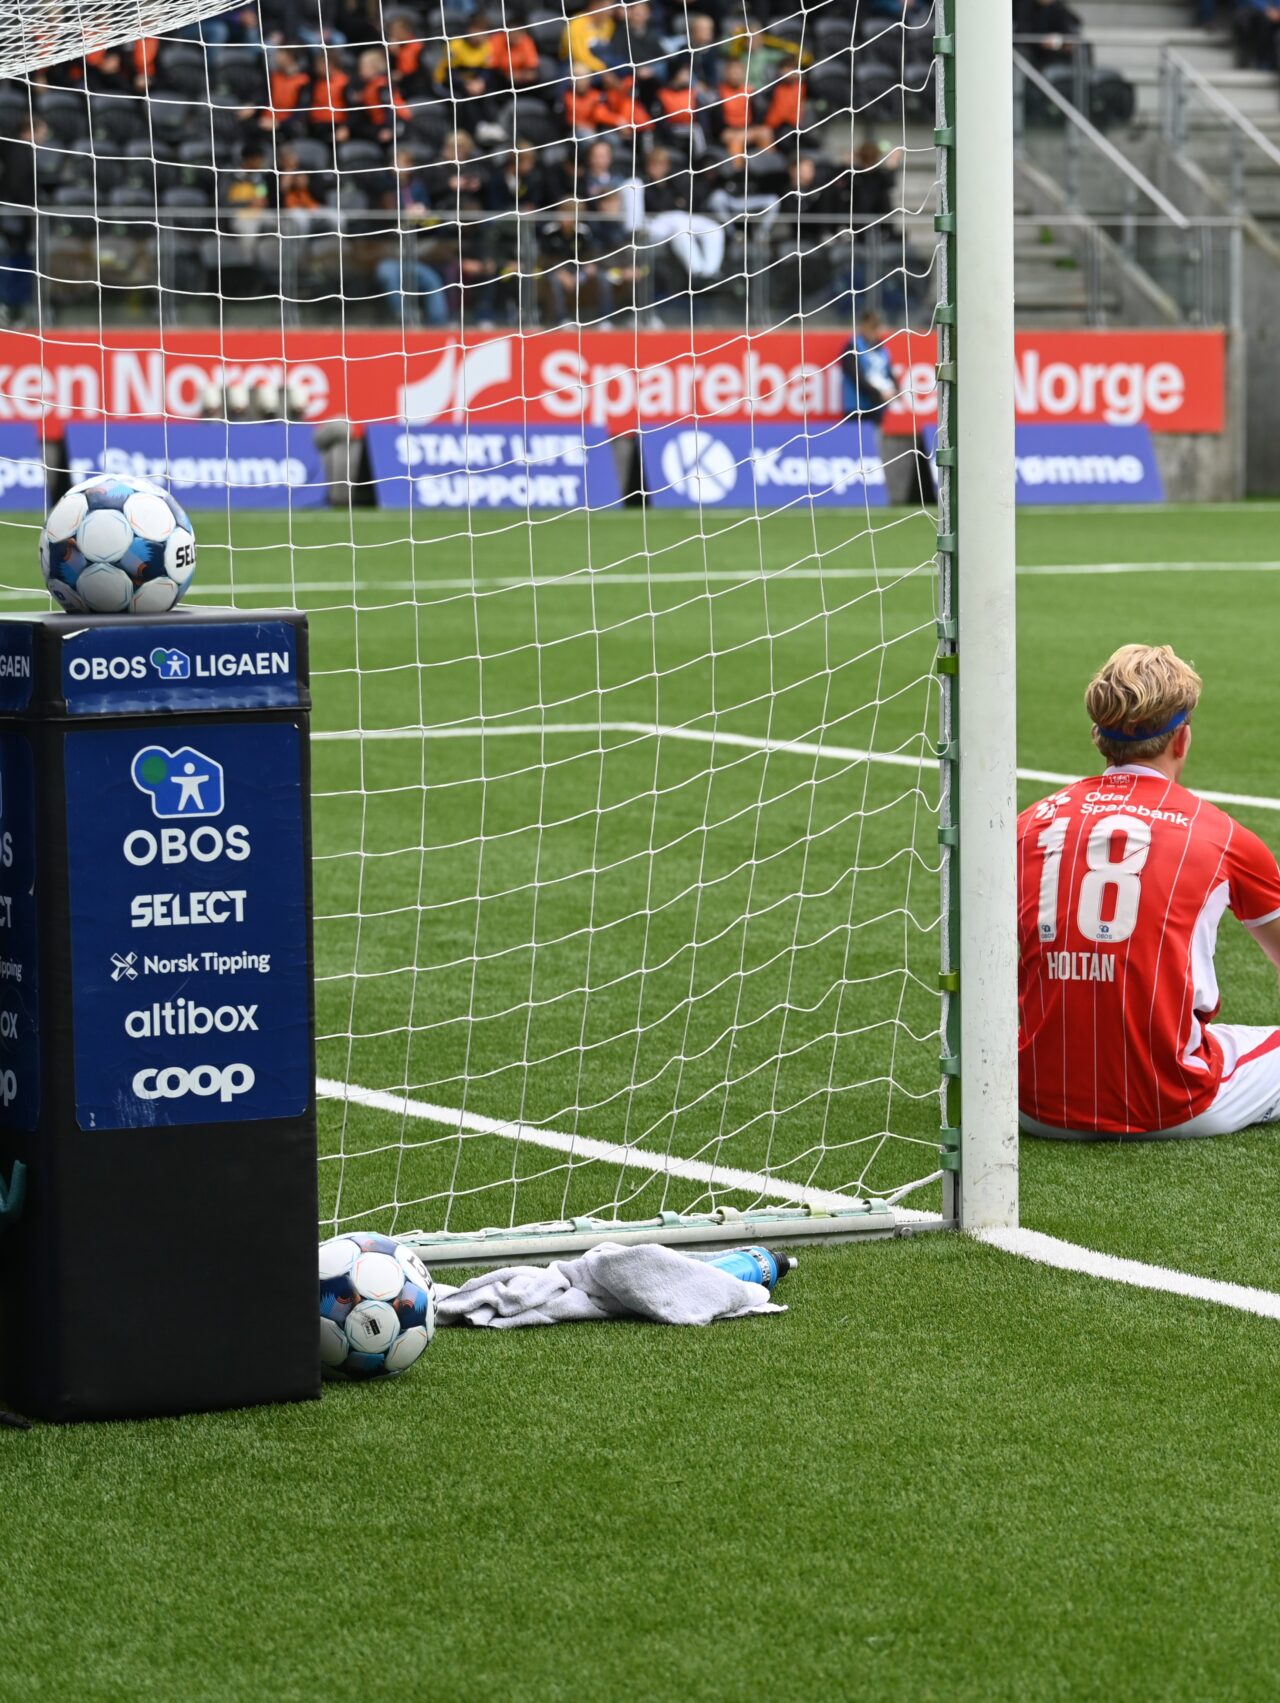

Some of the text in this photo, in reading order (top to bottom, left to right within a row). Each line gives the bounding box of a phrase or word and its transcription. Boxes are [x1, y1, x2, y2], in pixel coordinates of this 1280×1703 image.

[396, 434, 588, 467] START LIFE
[416, 475, 580, 507] SUPPORT
[69, 652, 290, 680] OBOS LIGAEN
[1085, 791, 1130, 803] Odal
[1080, 803, 1190, 828] Sparebank
[123, 825, 251, 866] OBOS
[1037, 814, 1152, 944] 18
[130, 890, 247, 928] SELECT
[143, 951, 271, 975] Norsk Tipping
[1047, 951, 1116, 983] HOLTAN
[124, 998, 259, 1039] altibox
[132, 1063, 256, 1103] coop
